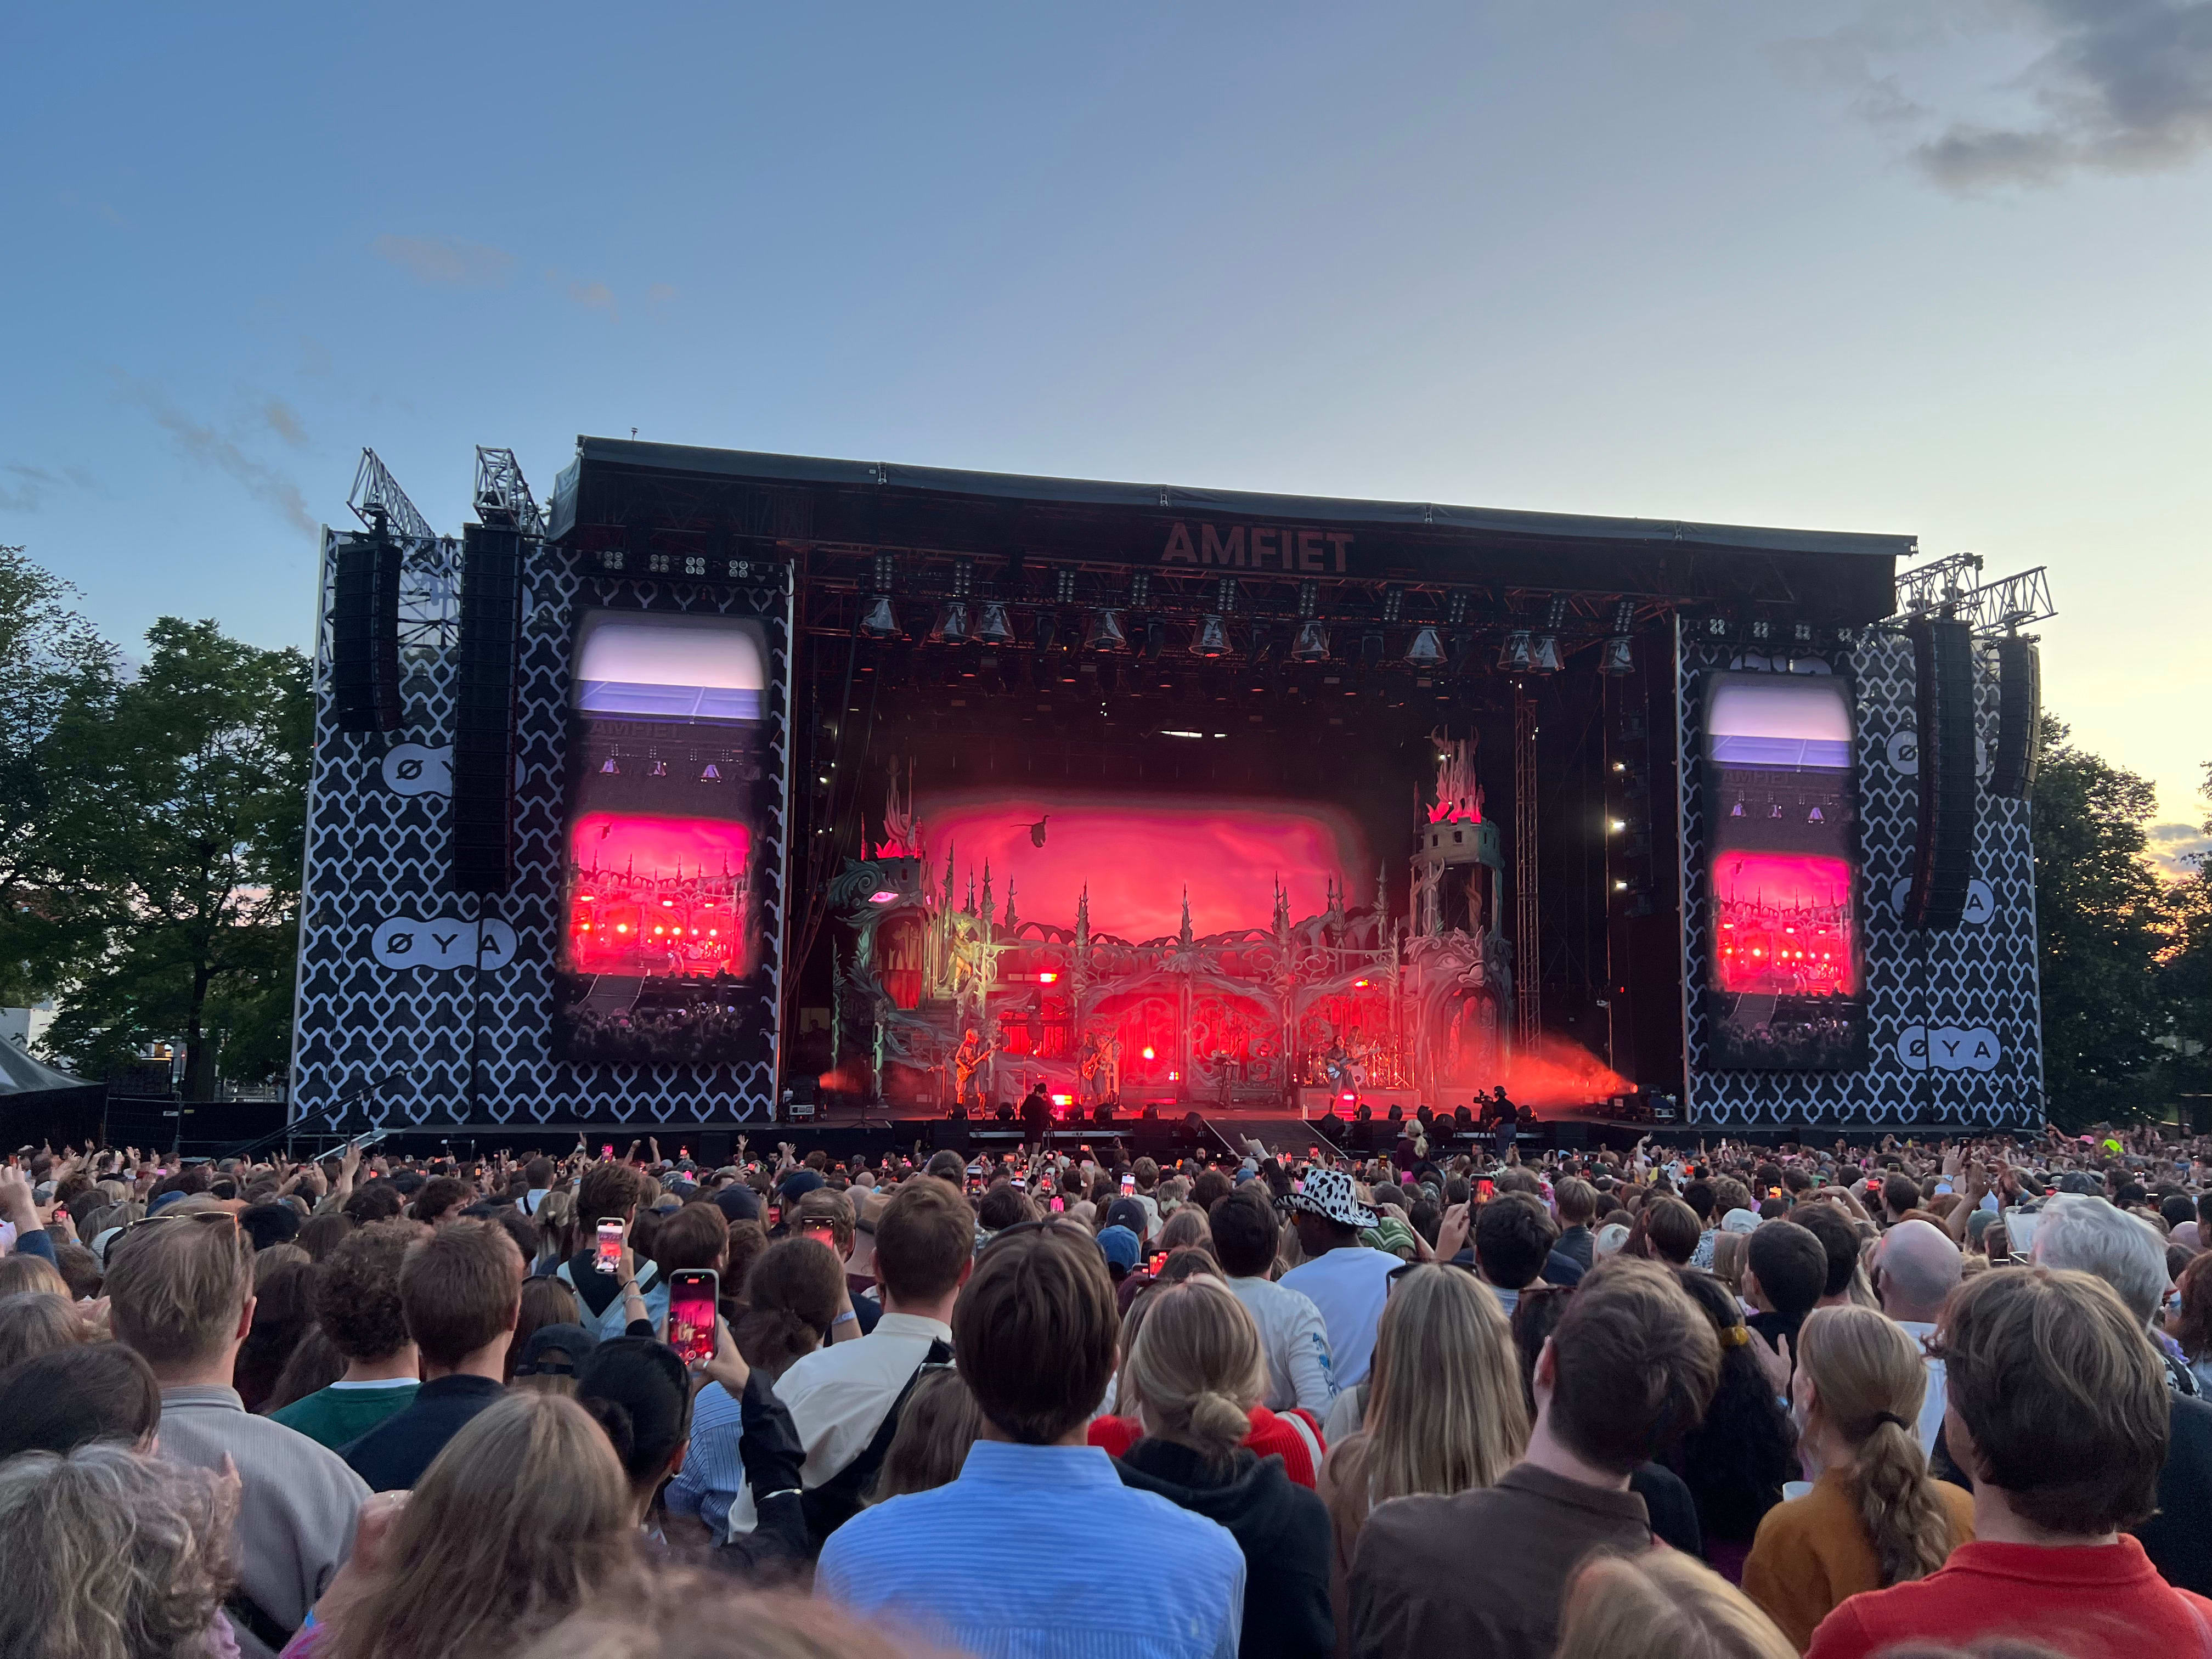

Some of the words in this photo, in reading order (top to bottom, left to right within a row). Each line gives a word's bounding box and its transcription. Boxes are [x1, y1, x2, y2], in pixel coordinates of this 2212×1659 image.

[1160, 522, 1355, 572] AMFIET
[386, 933, 501, 955] ØYA
[1909, 1039, 1991, 1058] ØYA
